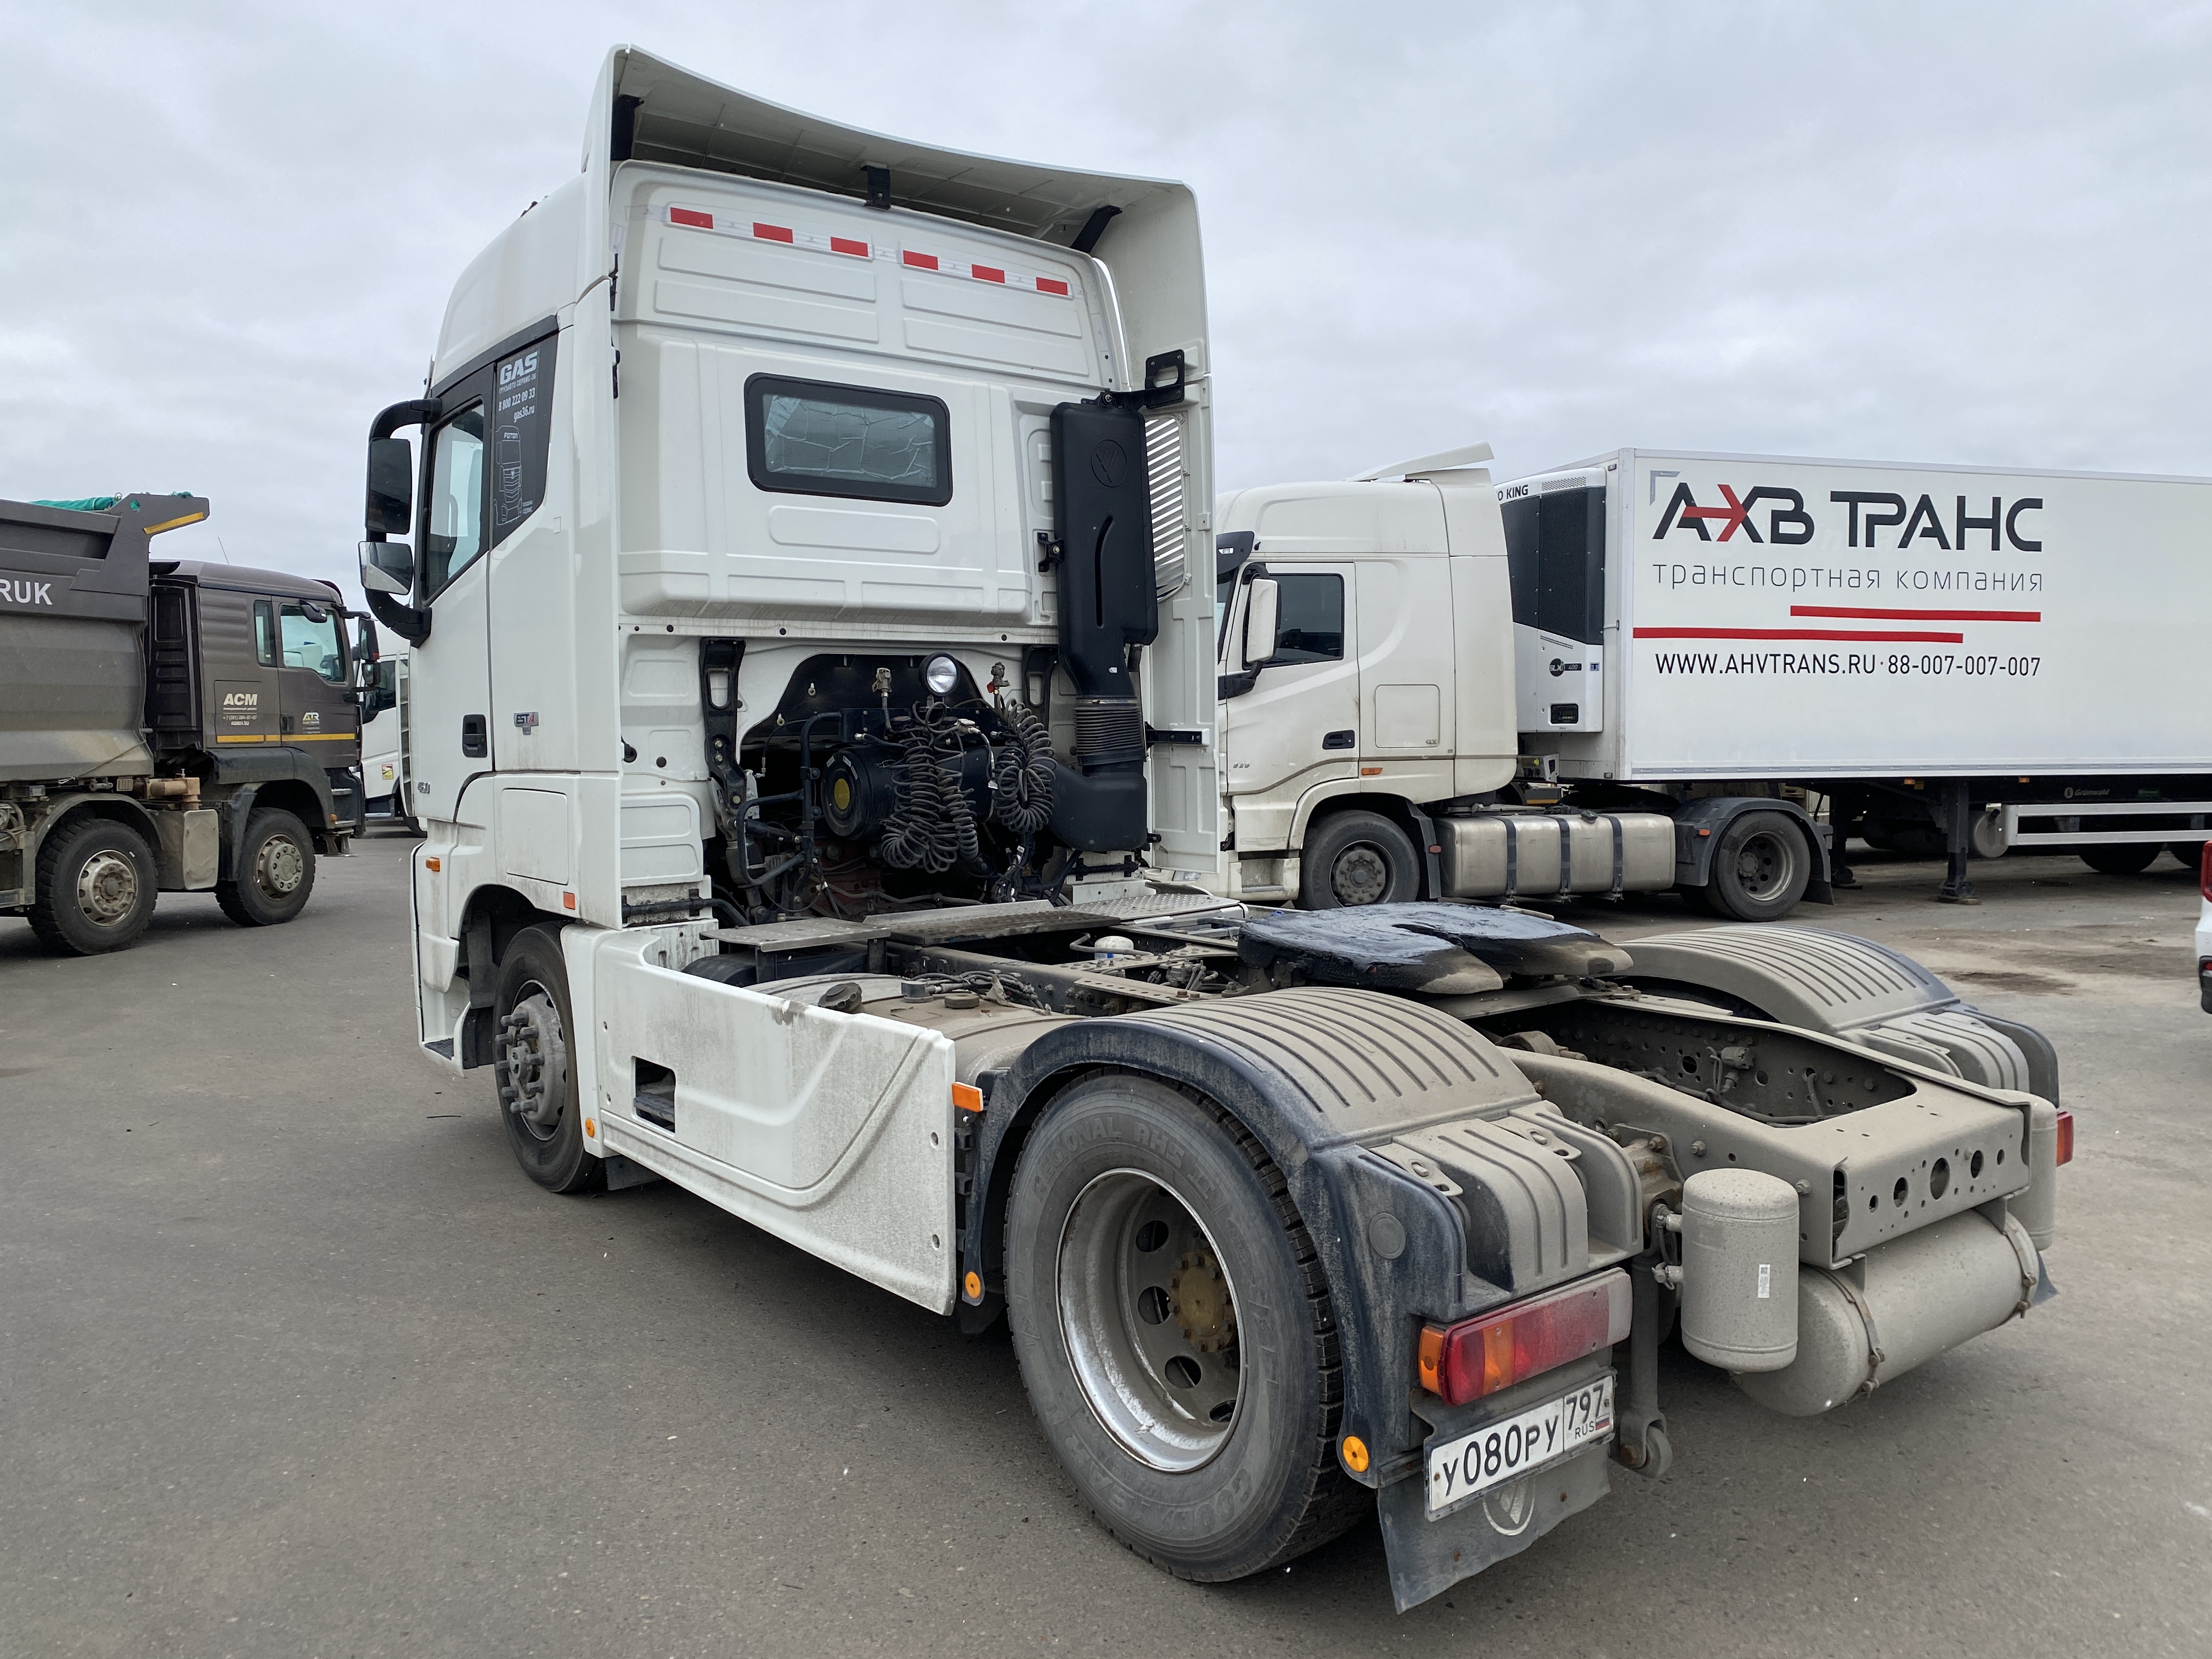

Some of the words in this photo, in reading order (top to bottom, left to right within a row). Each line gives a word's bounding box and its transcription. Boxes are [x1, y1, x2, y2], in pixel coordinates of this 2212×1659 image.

[500, 351, 538, 385] GAS
[498, 401, 502, 411] 8
[503, 397, 511, 410] 800
[511, 393, 521, 406] 222
[521, 390, 528, 402] 09
[528, 387, 535, 399] 33
[514, 405, 535, 423] gas36.ru
[1506, 484, 1528, 499] KING
[1830, 490, 2043, 552] ТРАНС
[1652, 564, 1880, 592] транспортная
[1897, 570, 2042, 591] компания
[1655, 653, 1876, 674] WWW.AHVTRANS.RU
[1888, 654, 2041, 676] 88-007-007-007
[1134, 1122, 1185, 1169] RHS
[1566, 1385, 1605, 1431] 797
[1574, 1420, 1595, 1440] RUS
[1442, 1415, 1559, 1497] У080РУ
